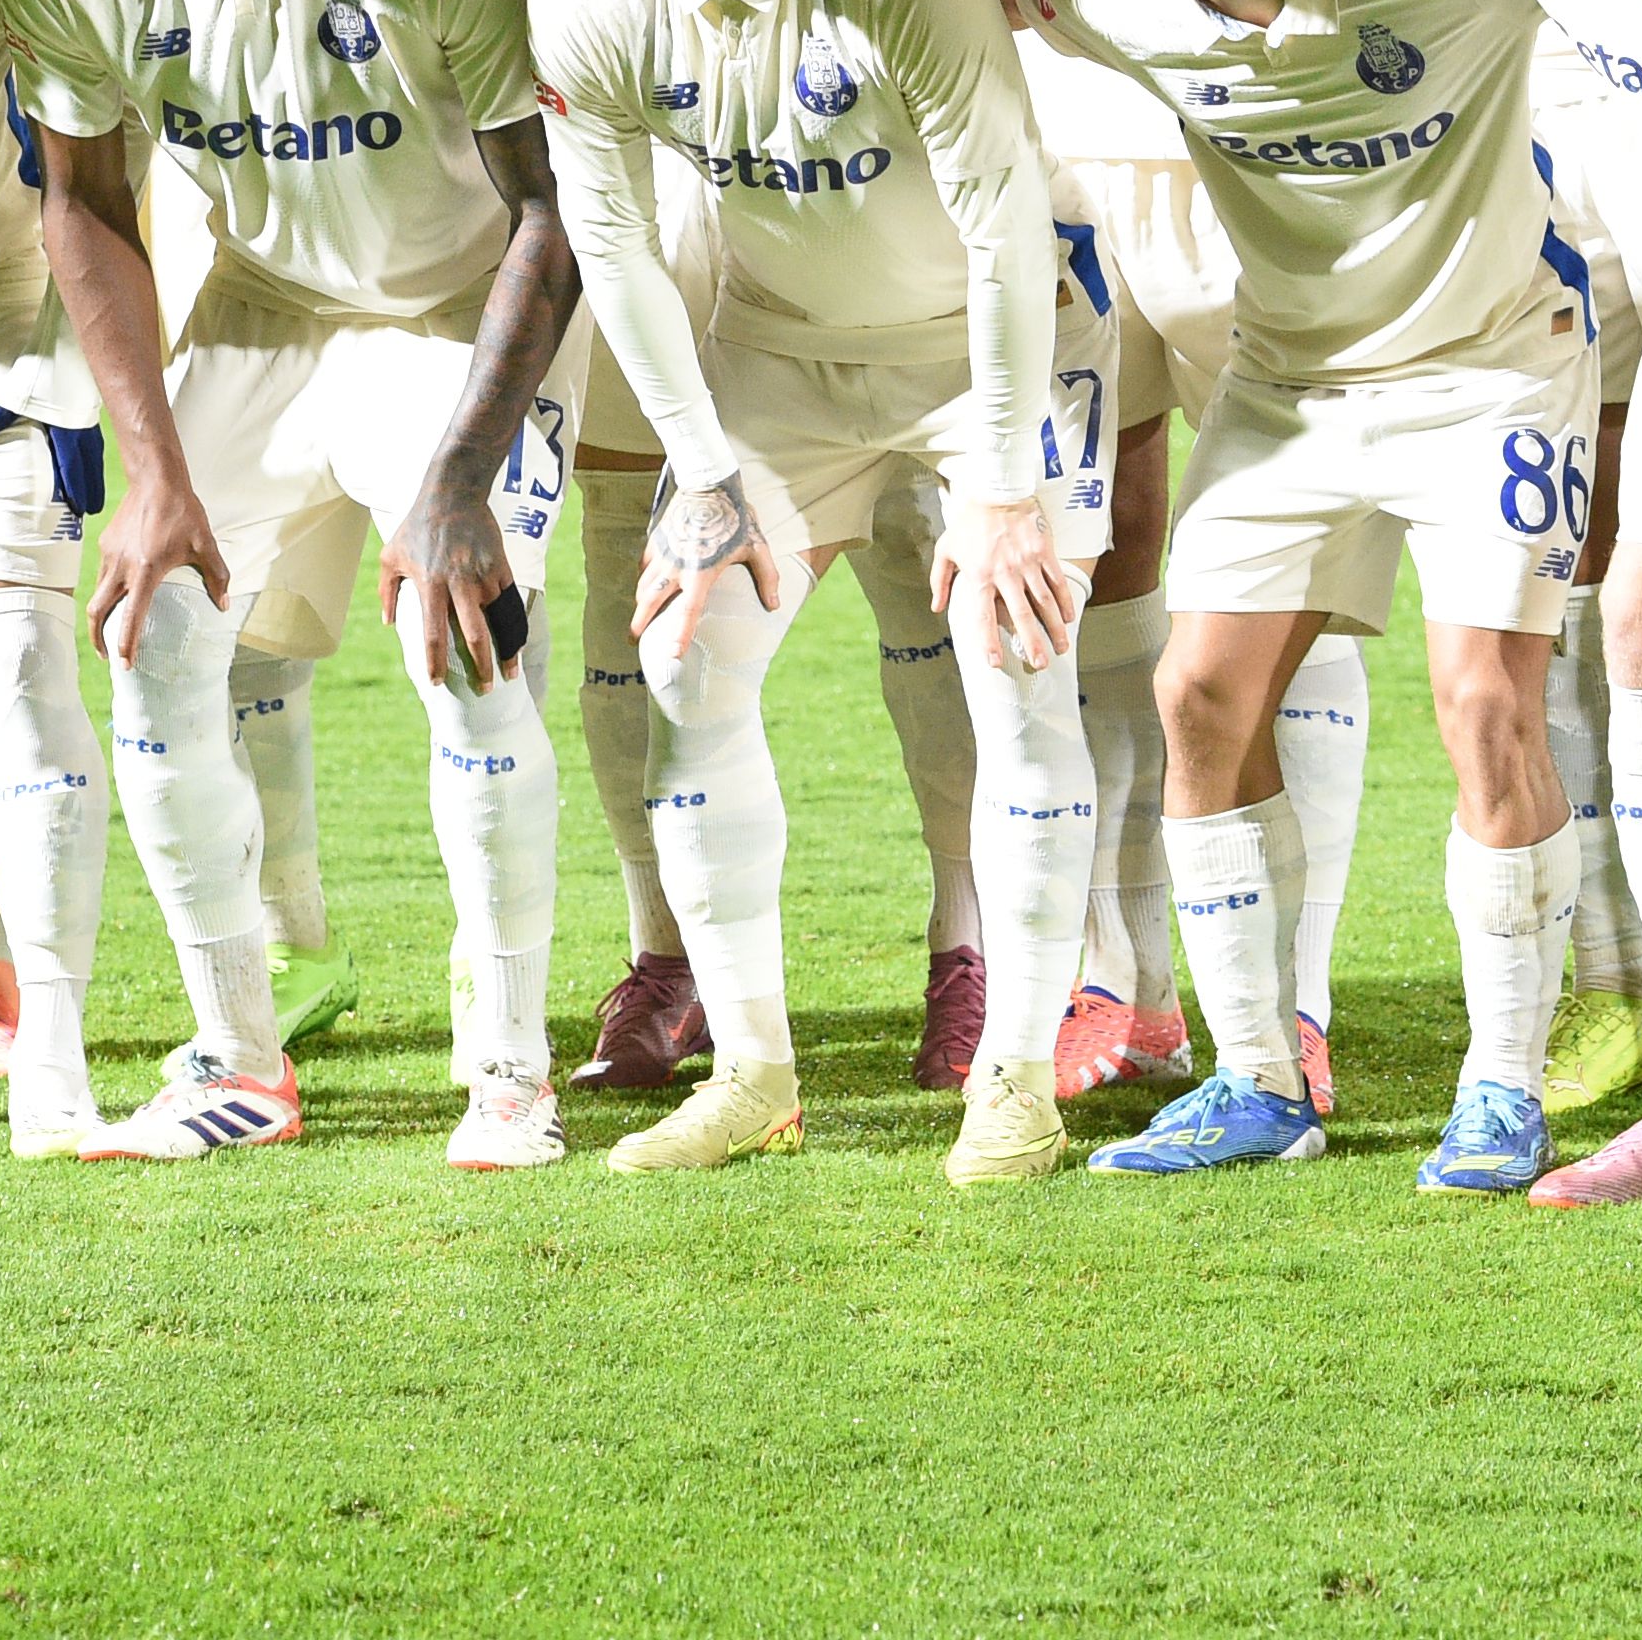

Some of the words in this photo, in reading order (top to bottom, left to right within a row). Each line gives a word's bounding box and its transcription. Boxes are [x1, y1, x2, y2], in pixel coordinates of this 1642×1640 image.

[163, 99, 402, 161] Betano
[1208, 112, 1454, 168] Betano
[671, 136, 891, 193] etano
[1500, 428, 1589, 543] 86
[1277, 709, 1354, 727] orto
[646, 792, 706, 809] orto
